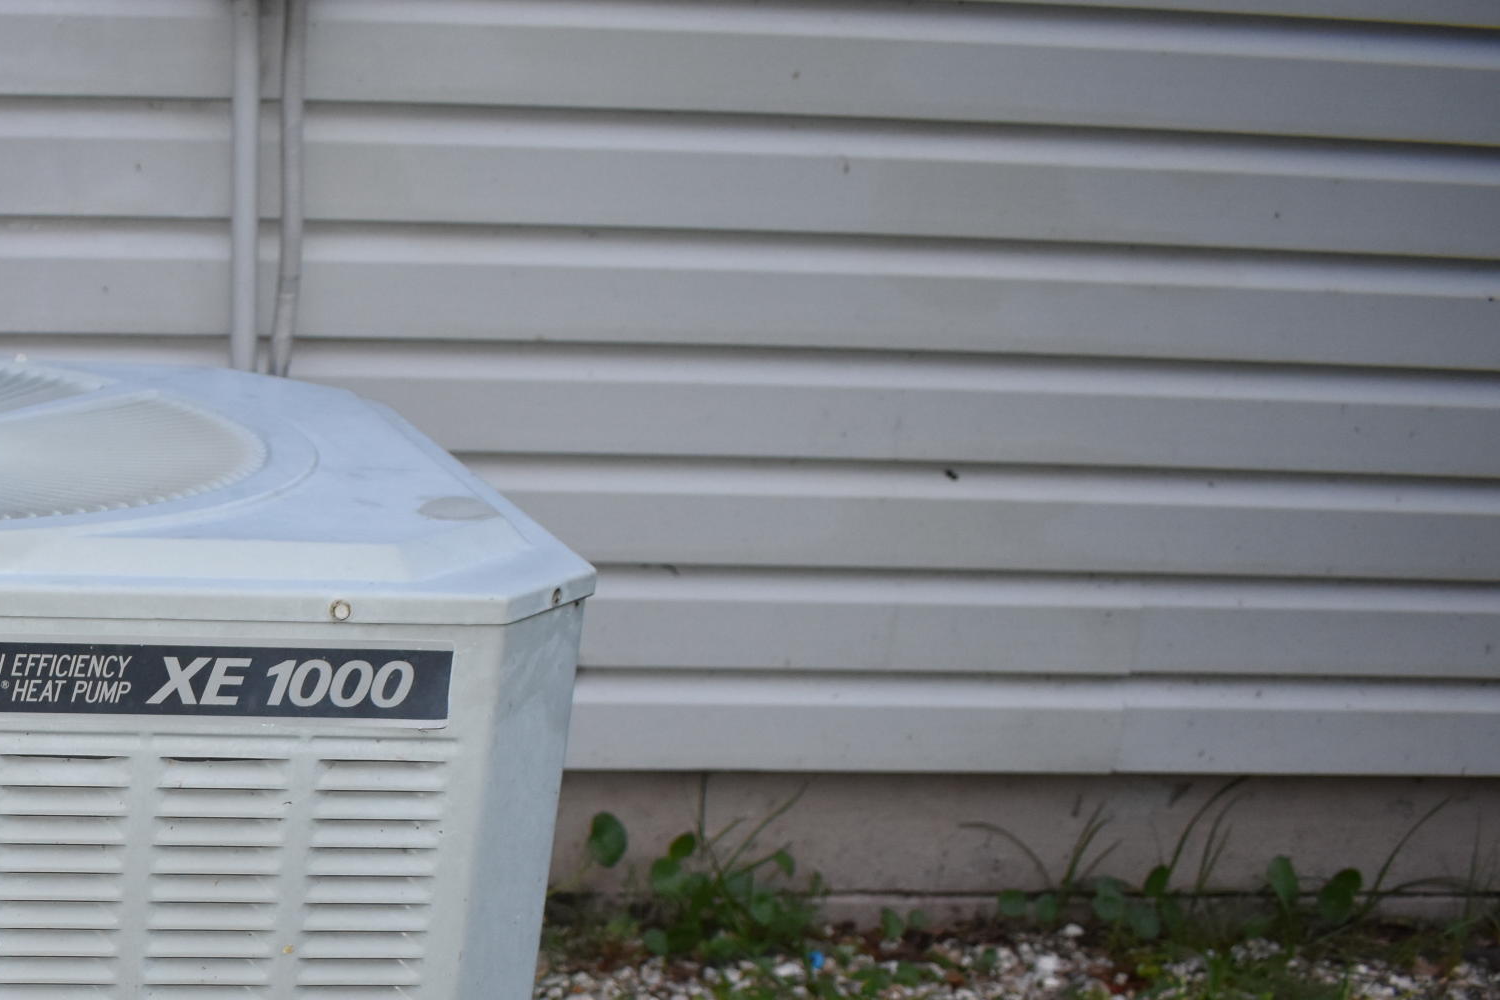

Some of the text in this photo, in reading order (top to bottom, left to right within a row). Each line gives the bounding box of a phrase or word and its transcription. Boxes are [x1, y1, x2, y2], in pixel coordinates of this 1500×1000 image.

[11, 653, 132, 679] EFFICIENCY
[11, 679, 66, 703] HEAT
[71, 680, 131, 704] PUMP
[145, 656, 415, 709] XE 1000
